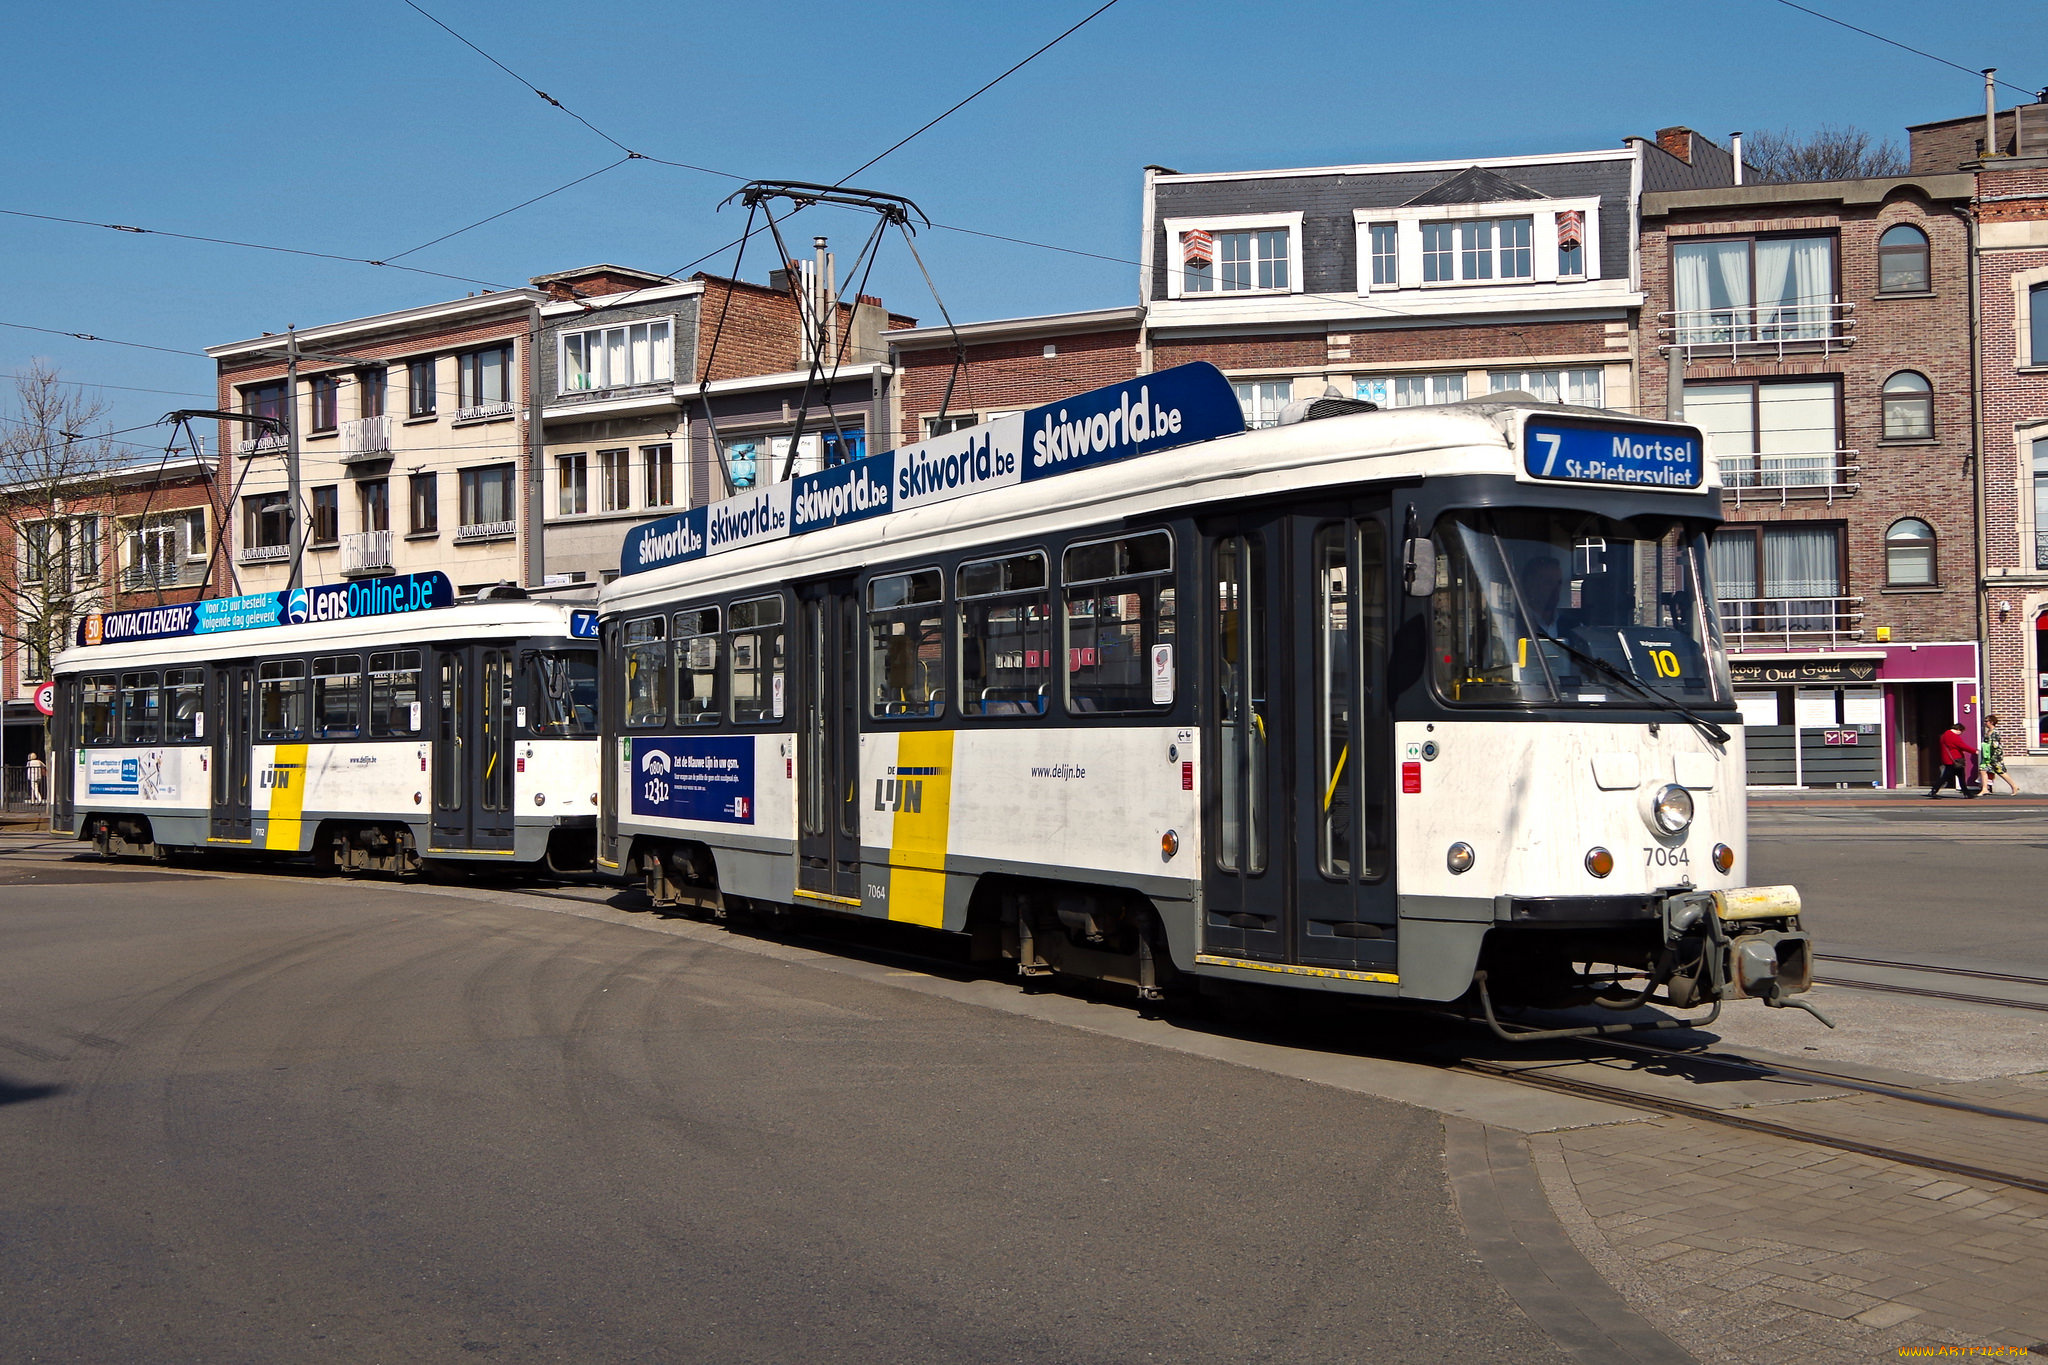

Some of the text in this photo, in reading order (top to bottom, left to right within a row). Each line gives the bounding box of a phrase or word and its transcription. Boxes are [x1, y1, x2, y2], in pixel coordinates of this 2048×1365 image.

[1033, 385, 1182, 468] skiworld.be
[1535, 433, 1561, 476] 7
[1612, 436, 1692, 463] Mortsel
[898, 431, 1015, 500] skiworld.be
[795, 465, 888, 525] skiworld.be
[710, 494, 785, 546] skiworld.be
[639, 517, 701, 565] skiworld.be
[205, 602, 219, 614] Voor
[220, 600, 229, 611] 23
[229, 600, 240, 611] uur
[241, 595, 266, 610] besteld
[88, 619, 99, 639] 50
[104, 606, 192, 639] CONTACTLENZEN?
[202, 609, 275, 632] Volgende dag geleverd
[577, 614, 590, 635] 7
[1648, 650, 1681, 678] 10
[1765, 668, 1797, 681] Oud
[1802, 662, 1840, 676] Goud
[1963, 703, 1971, 713] 3
[260, 770, 290, 789] LIJN
[887, 766, 895, 775] DE
[1031, 764, 1086, 781] www.delijn.be
[644, 777, 669, 805] 12312
[874, 779, 923, 813] LIJN
[1643, 847, 1690, 867] 7064
[867, 884, 886, 899] 7064
